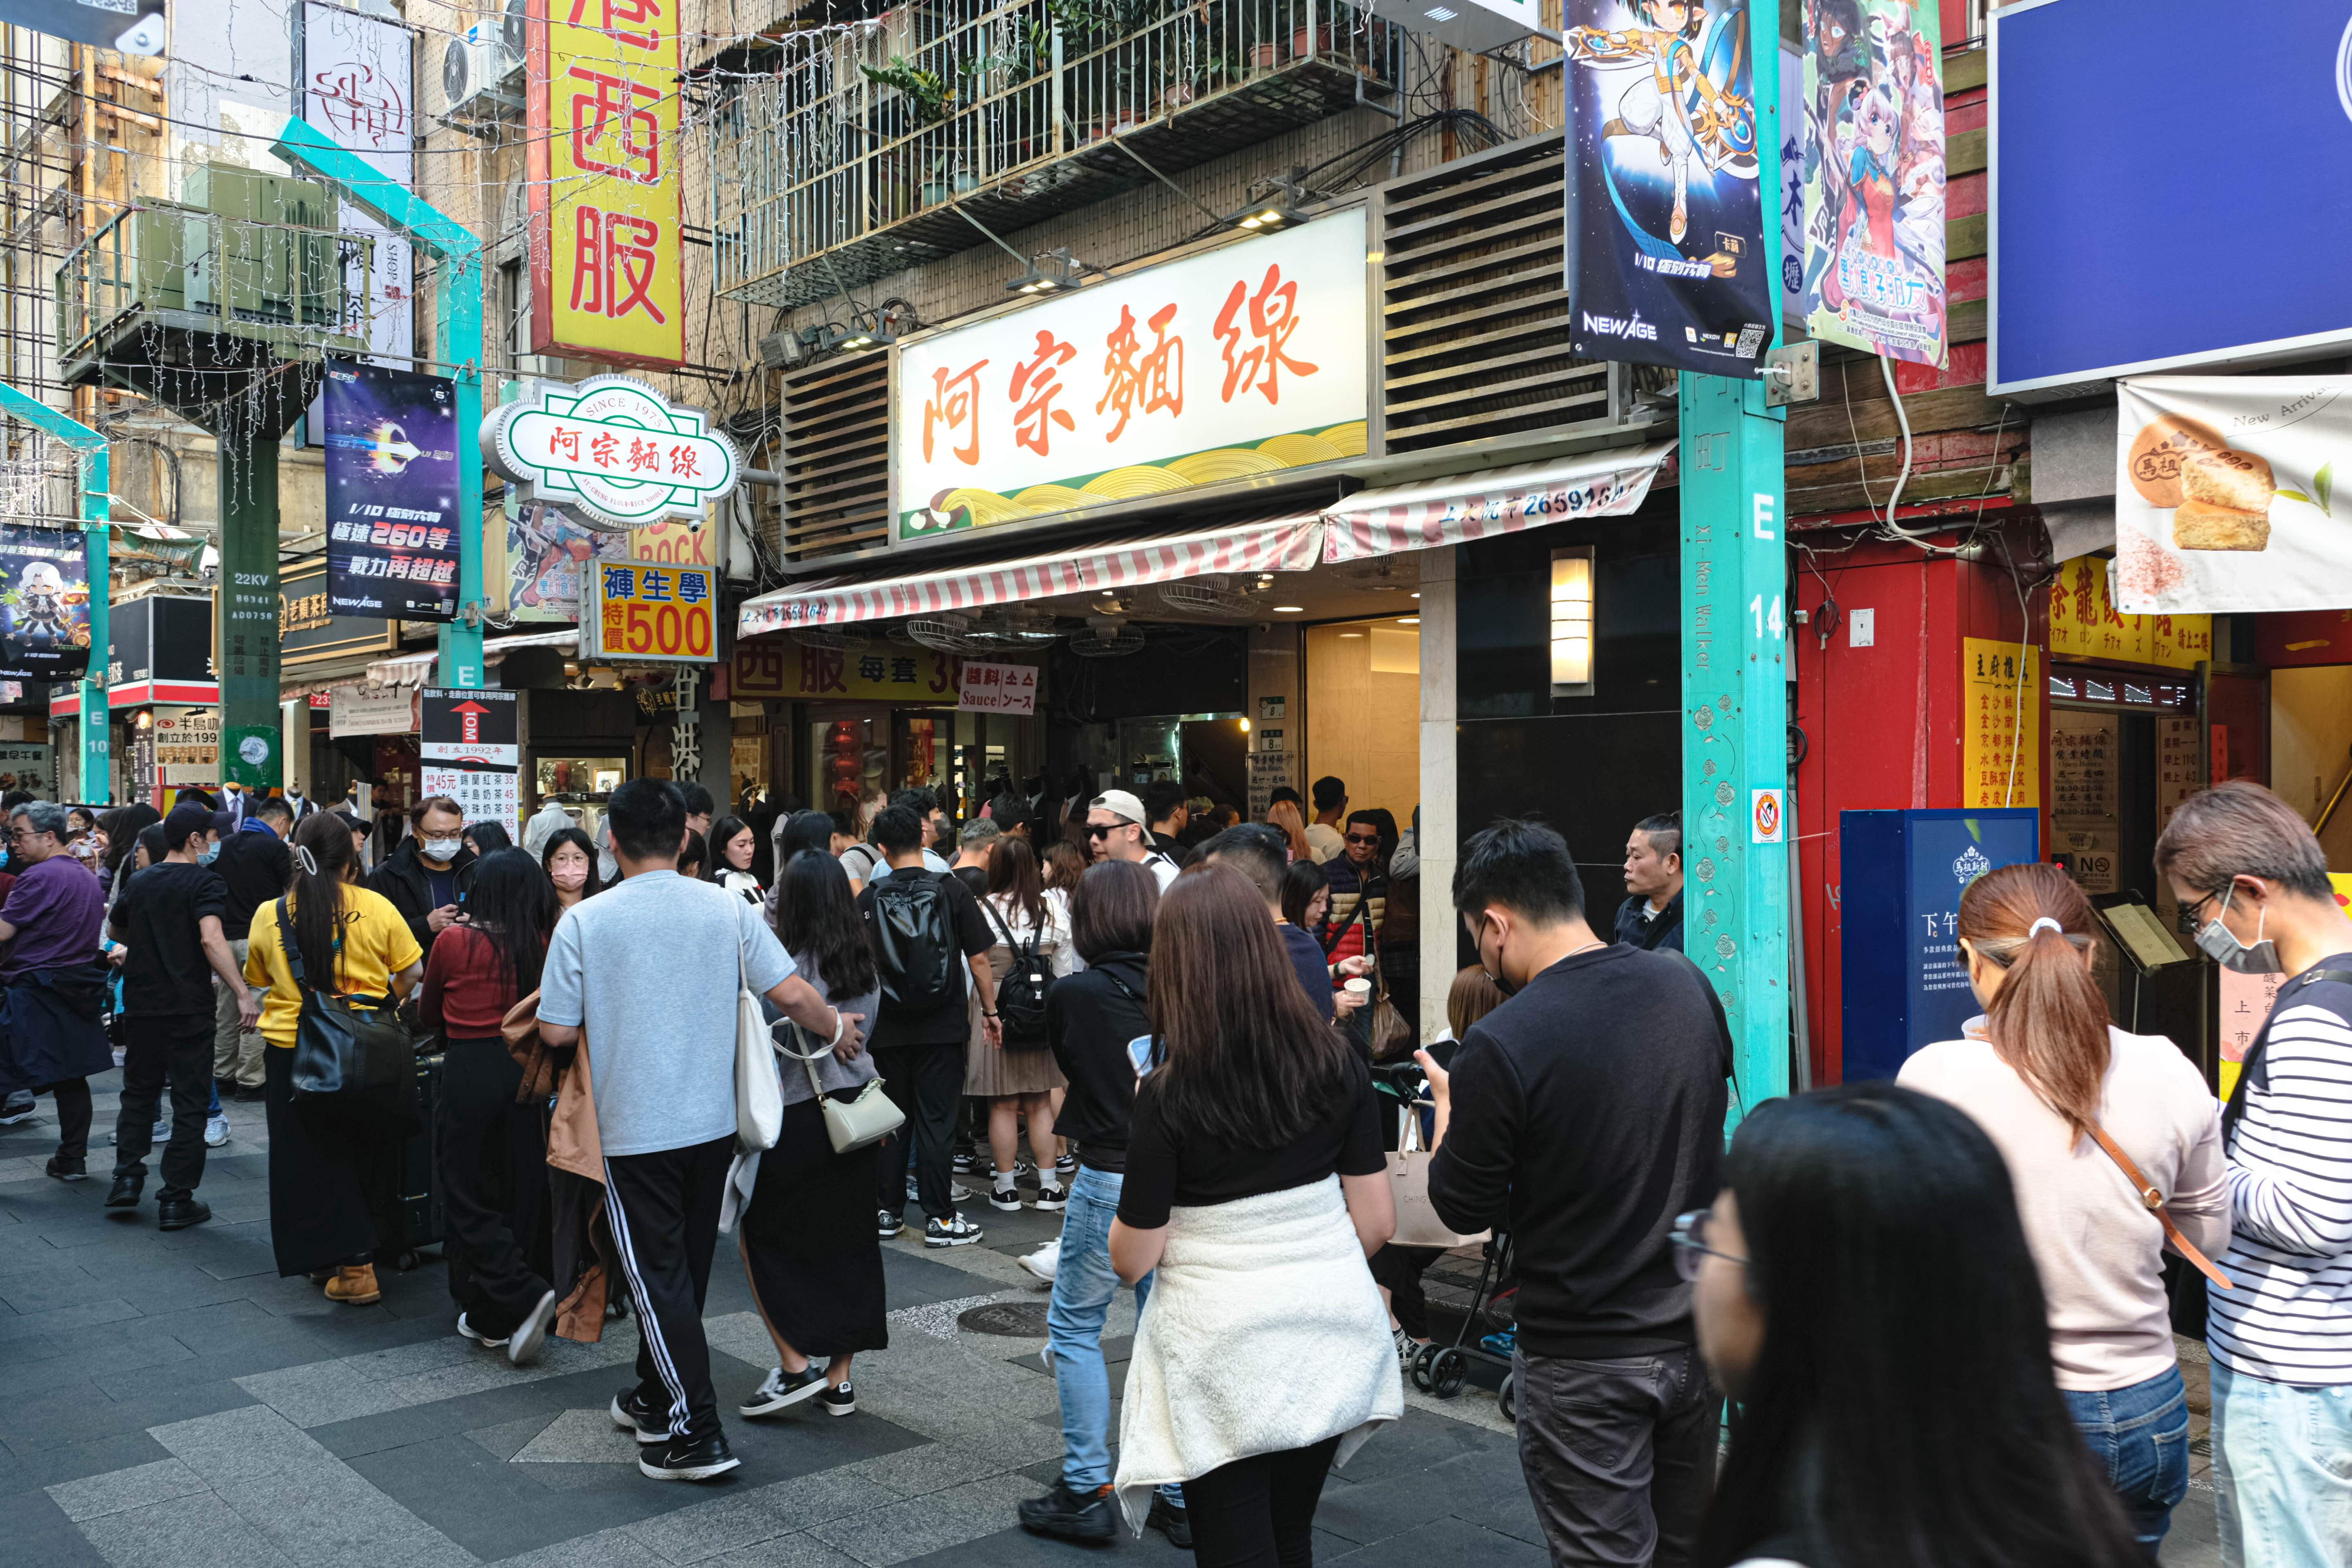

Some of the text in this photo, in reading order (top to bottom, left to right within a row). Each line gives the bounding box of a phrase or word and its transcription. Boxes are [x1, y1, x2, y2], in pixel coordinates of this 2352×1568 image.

[922, 263, 1319, 465] 阿宗麵線
[586, 398, 663, 427] SINCE 1975
[2233, 413, 2270, 426] New
[549, 426, 702, 479] 阿宗麵線
[582, 478, 608, 501] AY-CHUNG
[646, 487, 665, 505] NOODLE
[349, 503, 384, 517] 1/10
[1753, 493, 1775, 540] E
[331, 521, 451, 550] 極速260等
[348, 555, 456, 582] 戰力再超越
[235, 573, 269, 586] 22KV
[232, 611, 273, 620] AD0758
[1750, 594, 1782, 639] 14
[602, 602, 624, 652] 特價
[627, 603, 711, 657] 500
[737, 639, 847, 693] 西服
[859, 655, 917, 684] 每套
[458, 666, 475, 687] E
[1005, 670, 1033, 686] 소스
[962, 690, 997, 706] Sauce
[90, 711, 104, 725] E
[1270, 706, 1275, 716] 8
[465, 712, 477, 740] 10M
[2172, 720, 2197, 732] 營業
[157, 733, 219, 743] 創立於199
[1269, 739, 1274, 749] 8
[88, 740, 107, 753] 10
[1980, 752, 2025, 767] 水煮牛肉
[426, 774, 456, 793] 特價 45元
[460, 774, 514, 785] 錫蘭紅茶 35
[460, 790, 514, 800] 半島奶茶 45
[461, 804, 514, 815] 珍珠奶茶 50
[505, 819, 514, 828] 55
[1955, 860, 1988, 873] 馬祖新村
[2235, 999, 2251, 1046] 上市
